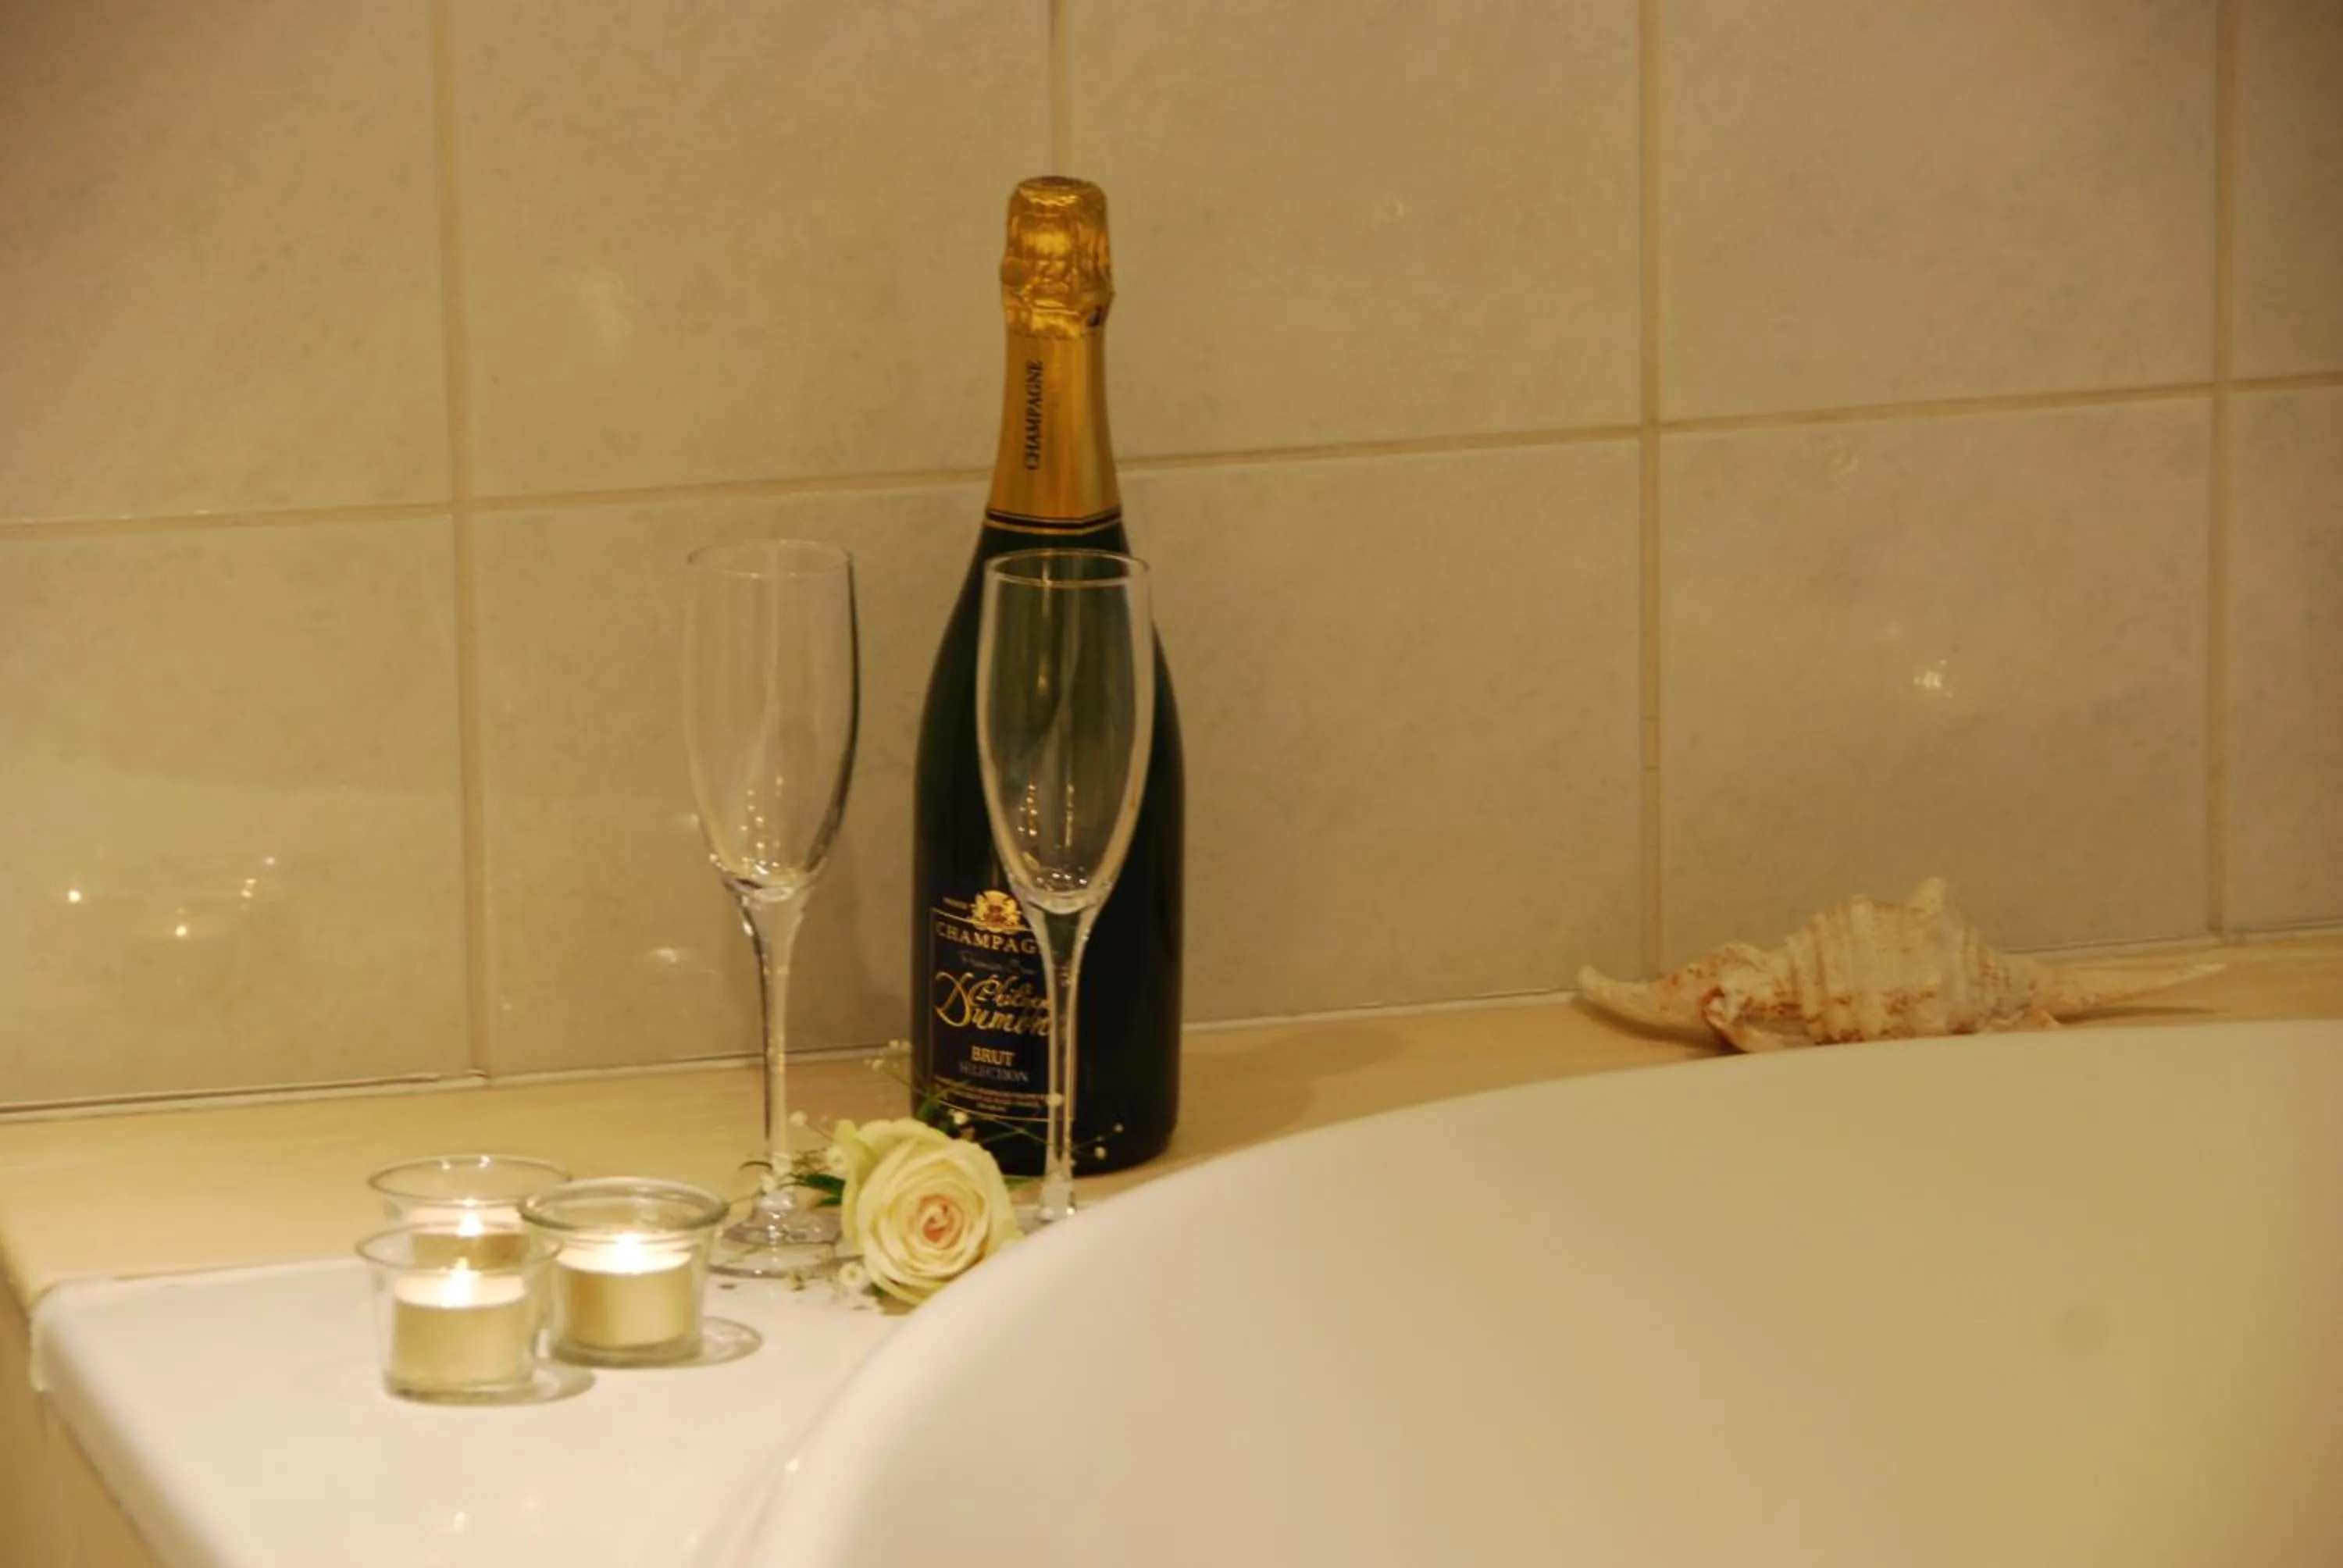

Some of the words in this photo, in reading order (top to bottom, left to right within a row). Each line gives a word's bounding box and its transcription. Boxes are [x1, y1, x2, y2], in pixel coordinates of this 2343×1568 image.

[1025, 360, 1043, 470] CHAMPAGNE
[936, 921, 1038, 954] CHAMPAG
[971, 1046, 1016, 1067] BRUT
